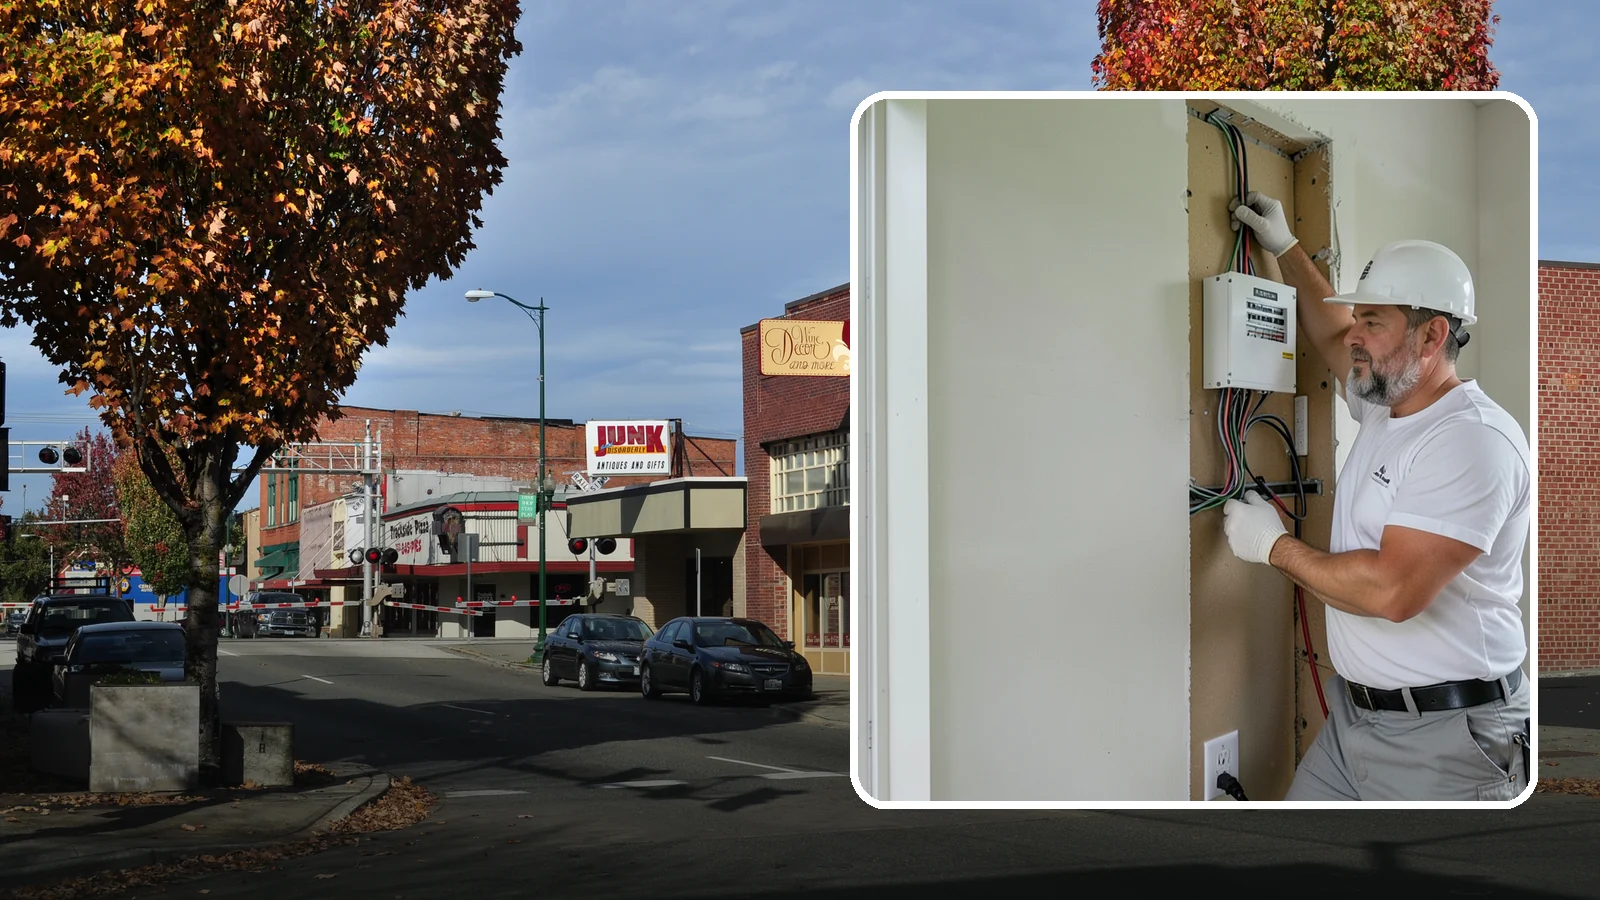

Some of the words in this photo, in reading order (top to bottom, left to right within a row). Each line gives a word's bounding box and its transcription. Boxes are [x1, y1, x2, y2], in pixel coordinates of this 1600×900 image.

[596, 425, 665, 457] JUNK
[607, 446, 646, 454] DISORDERLY
[597, 461, 628, 470] ANTIQUES
[631, 461, 644, 470] AND
[647, 460, 665, 469] GIFTS
[390, 521, 413, 540] Trackside
[414, 519, 429, 535] Pizza
